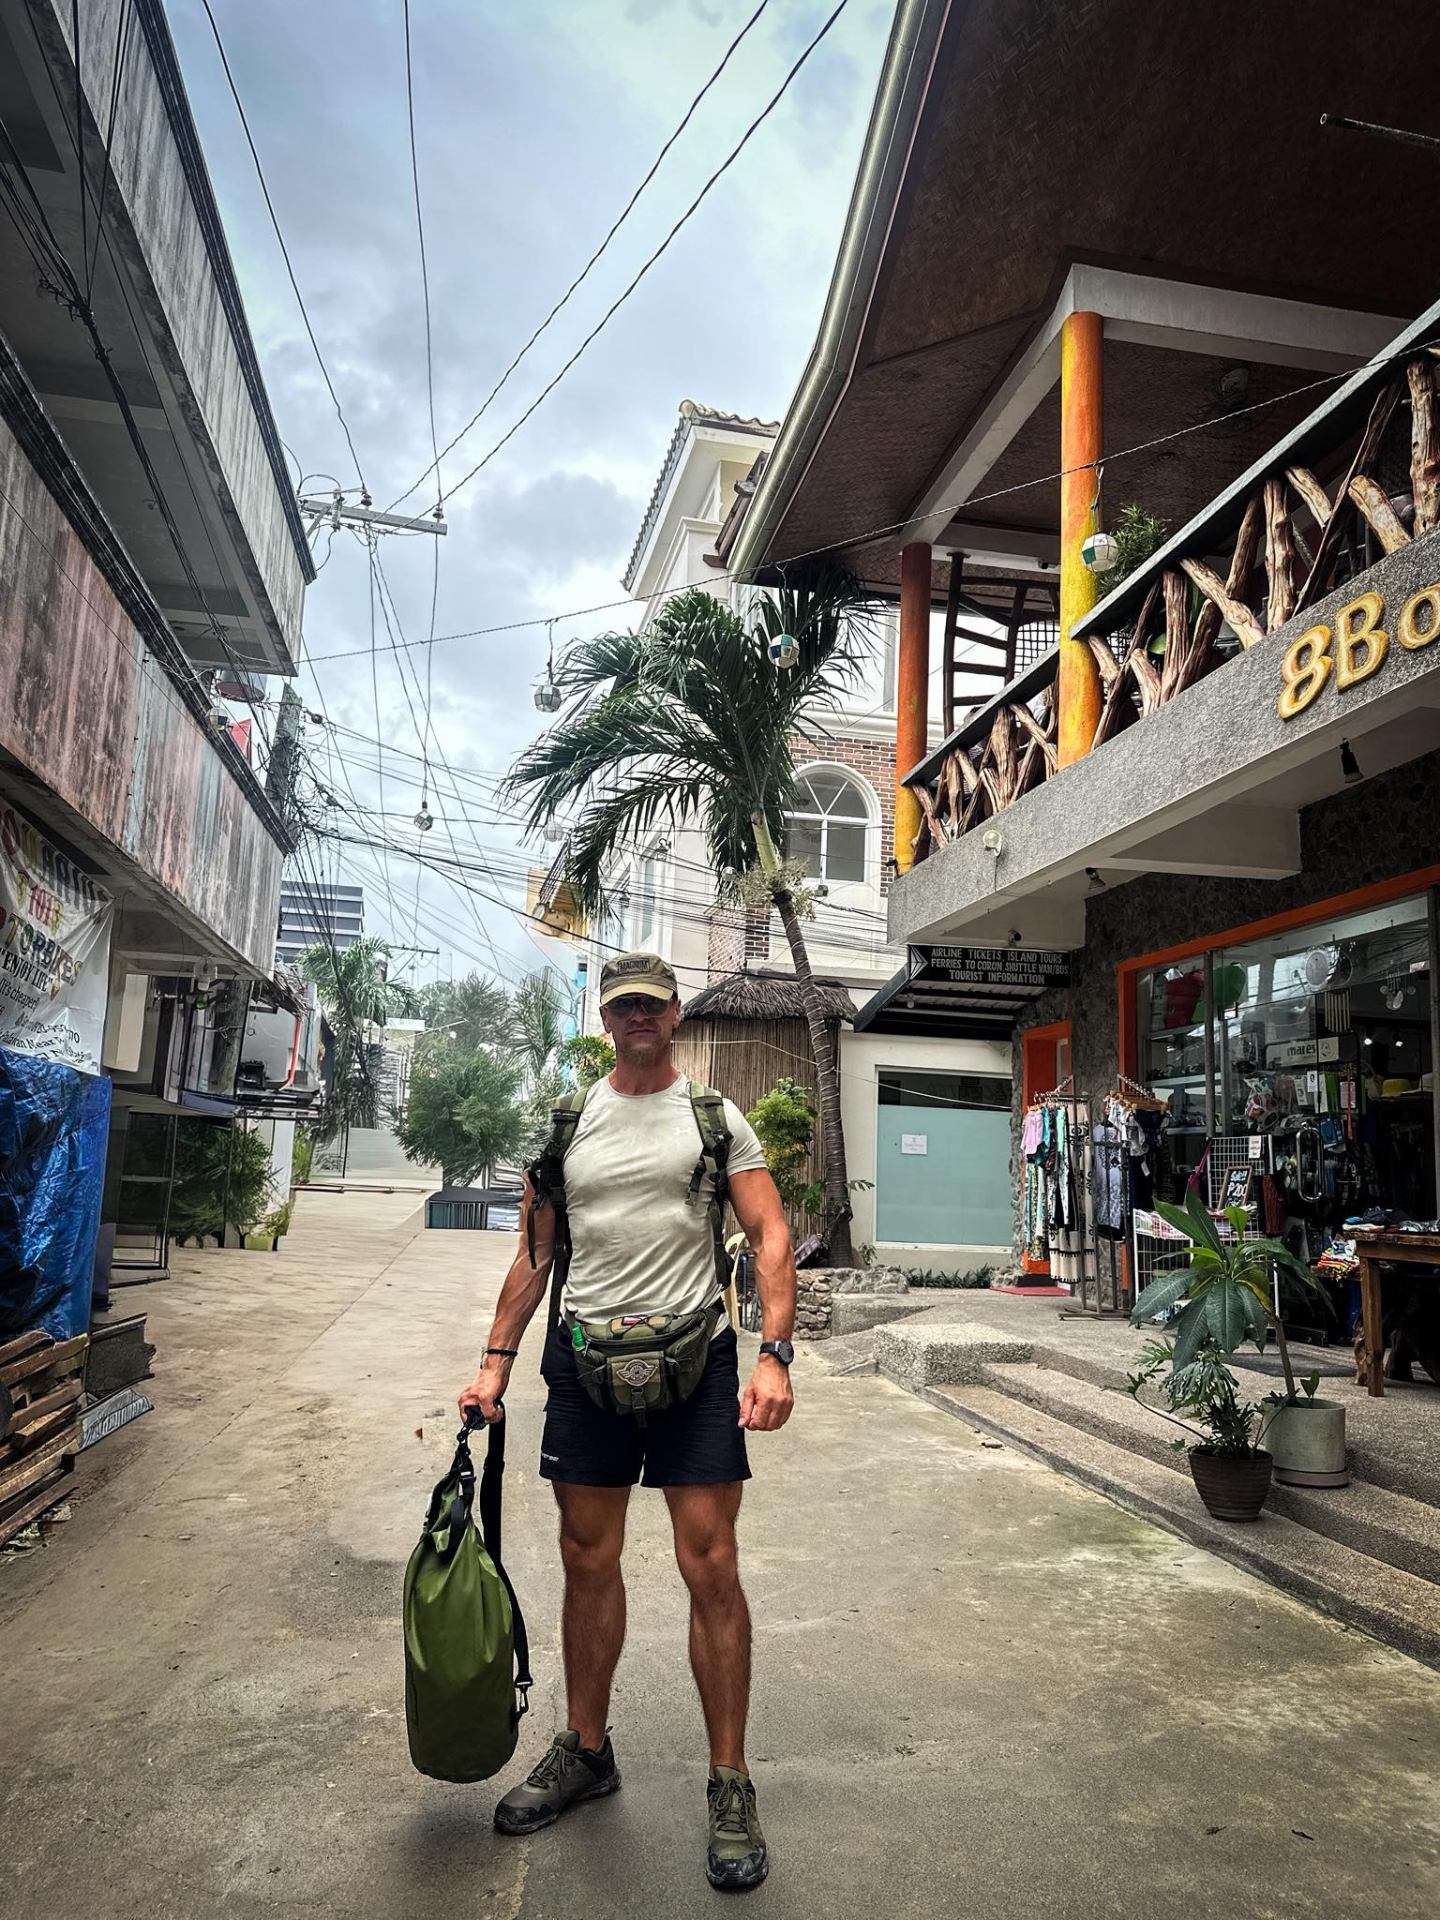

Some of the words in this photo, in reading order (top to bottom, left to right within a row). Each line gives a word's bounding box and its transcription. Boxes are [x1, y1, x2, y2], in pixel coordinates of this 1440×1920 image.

[931, 947, 963, 958] AIRLINE
[1007, 951, 1037, 963] ISLAND
[1038, 953, 1062, 964] TOURS
[931, 959, 962, 969] FERRIES
[965, 961, 976, 970] TO
[1005, 962, 1037, 973] SHUTTLE
[1038, 964, 1070, 975] VAN/BUS
[950, 971, 984, 982] TOURIST
[987, 972, 1046, 985] INFORMATION
[1287, 1044, 1316, 1057] mares
